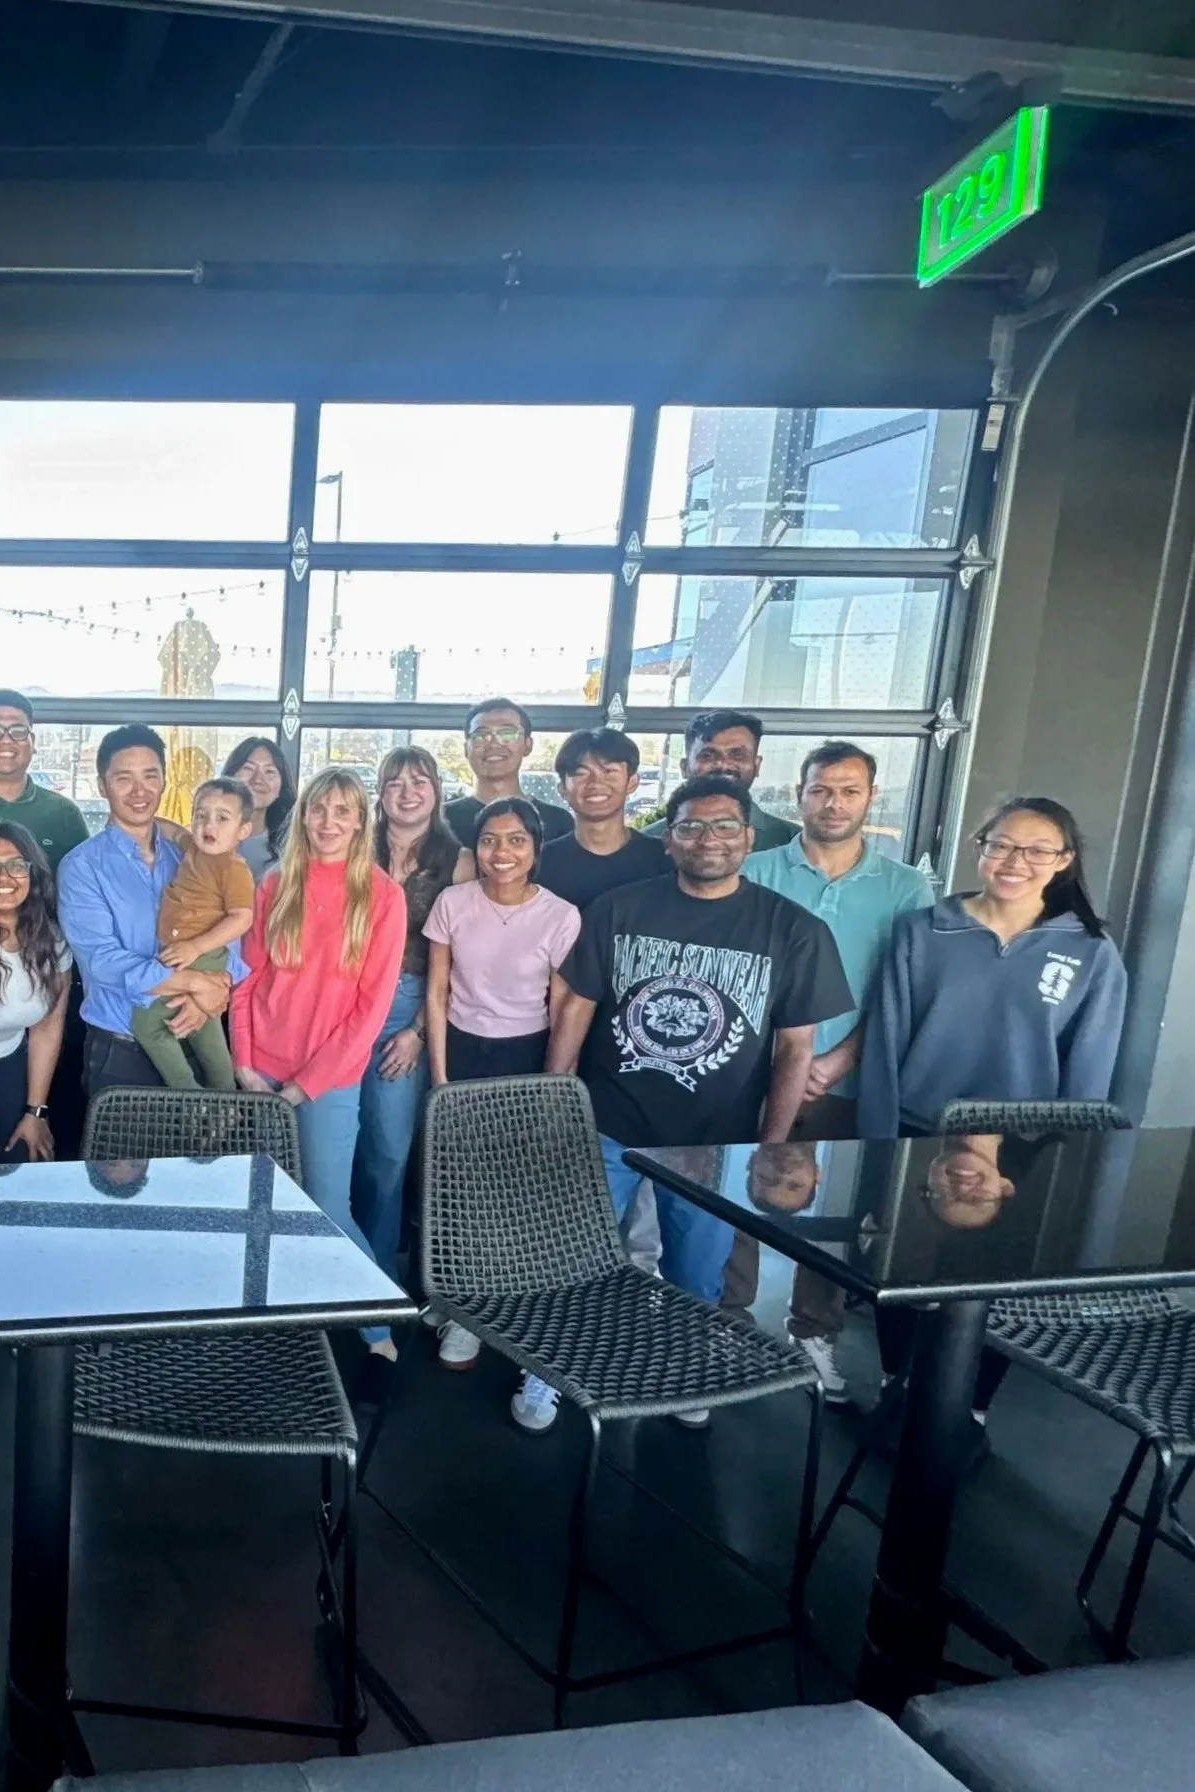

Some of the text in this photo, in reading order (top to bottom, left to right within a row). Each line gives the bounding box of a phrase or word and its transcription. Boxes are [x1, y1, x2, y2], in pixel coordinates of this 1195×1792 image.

[937, 154, 1006, 249] 129
[612, 933, 772, 1035] PACIFIC SUNWEAR
